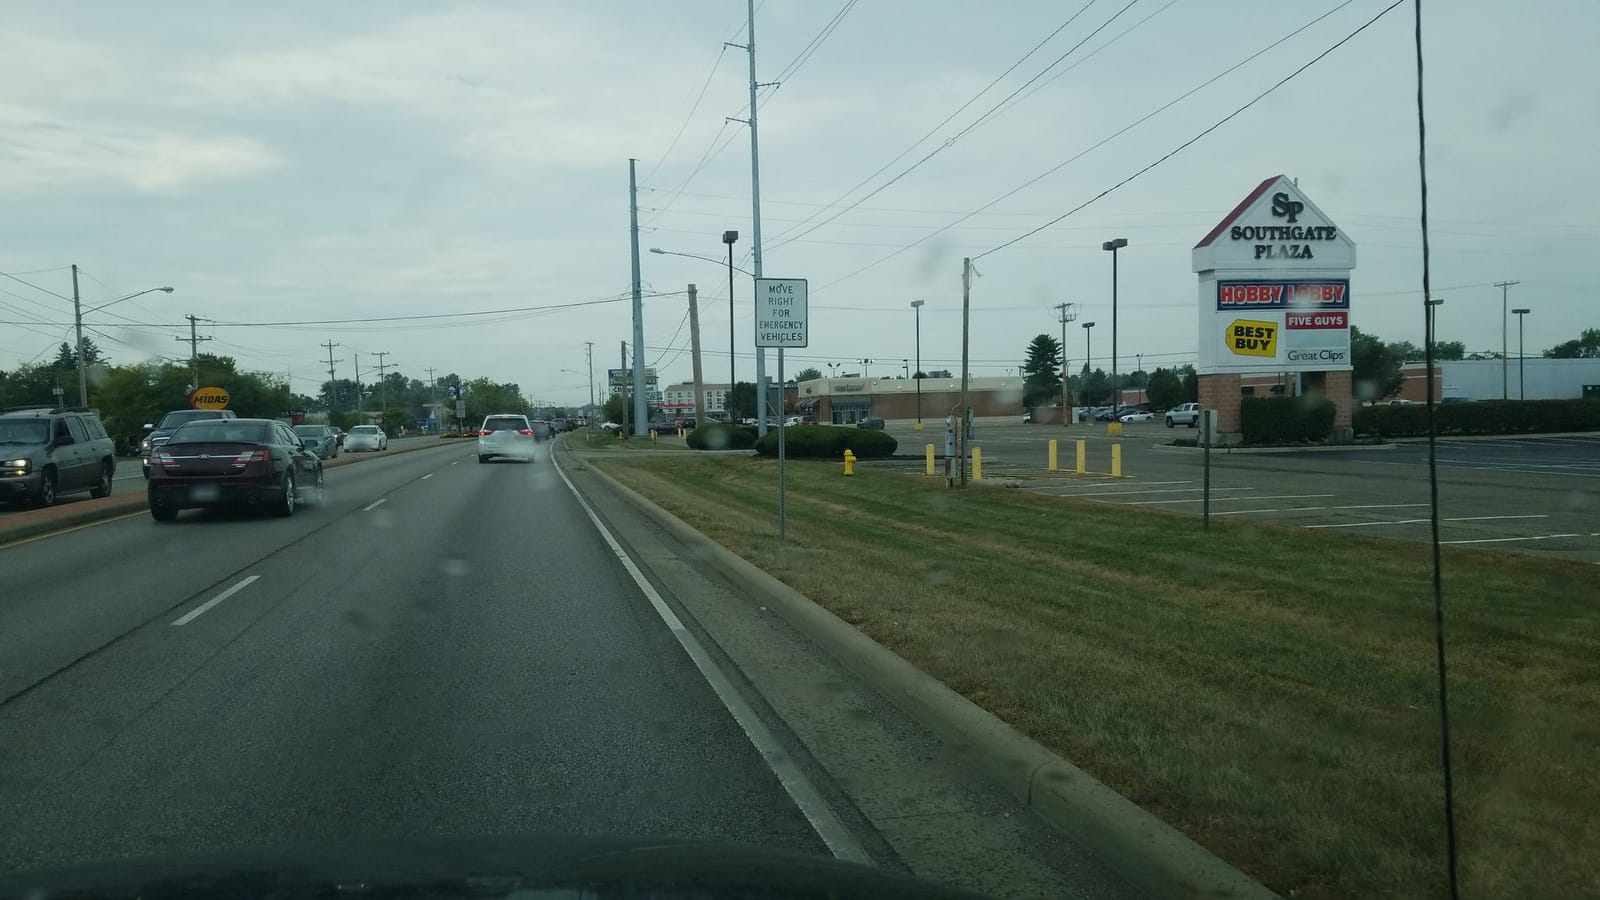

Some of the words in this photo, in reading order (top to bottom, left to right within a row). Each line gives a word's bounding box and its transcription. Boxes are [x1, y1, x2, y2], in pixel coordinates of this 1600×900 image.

[1230, 225, 1337, 241] SOUTHGATE
[1254, 244, 1314, 259] PLAZA
[768, 285, 793, 294] MOVE
[1220, 285, 1284, 304] HOBBY
[1286, 284, 1346, 303] LOBBY
[768, 297, 794, 306] RIGHT
[772, 309, 790, 318] FOR
[759, 320, 804, 330] EMERGENCY
[1288, 317, 1312, 326] FIVE
[1314, 316, 1344, 326] GUYS
[760, 332, 803, 341] VEHICLES
[1233, 325, 1275, 339] BEST
[1234, 338, 1271, 351] BUY
[1287, 350, 1318, 361] Great
